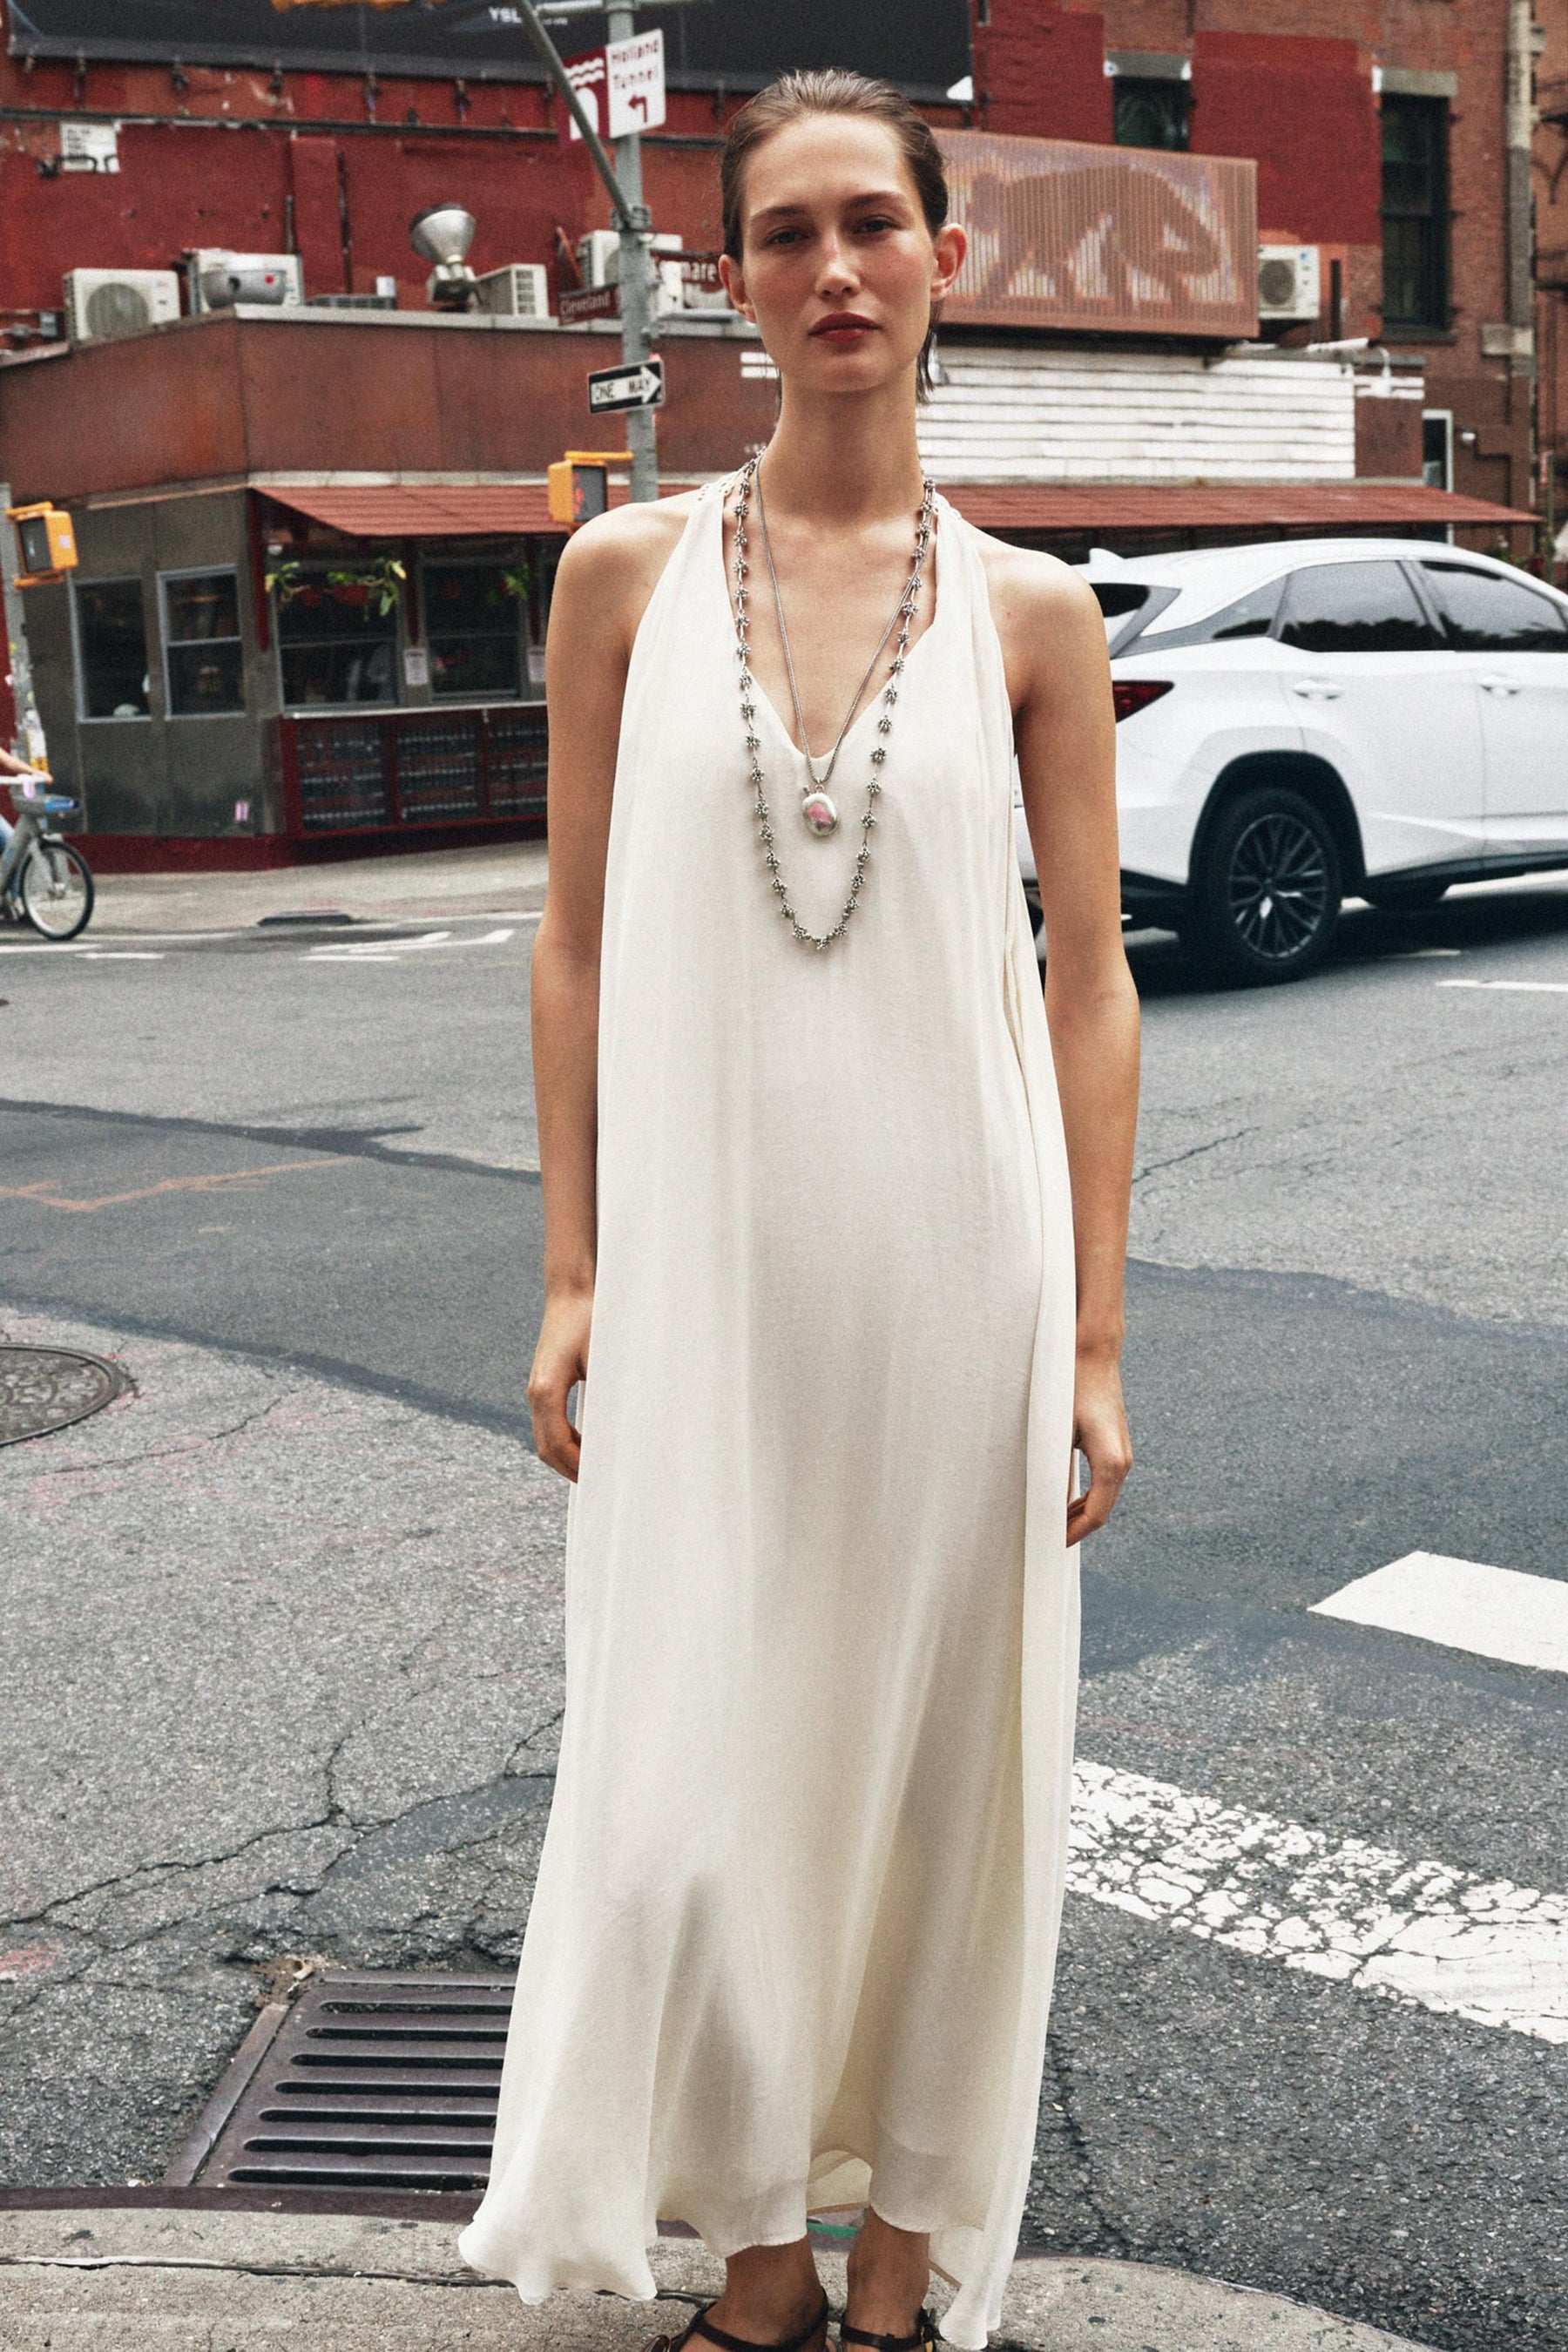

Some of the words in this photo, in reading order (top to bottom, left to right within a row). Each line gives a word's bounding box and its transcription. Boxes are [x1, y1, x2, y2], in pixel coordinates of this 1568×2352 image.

[489, 7, 523, 24] YSL
[612, 39, 659, 62] Holland
[613, 67, 659, 88] Tunnel
[559, 290, 610, 314] Cleveland
[594, 382, 614, 400] ONE
[629, 376, 651, 394] WAY
